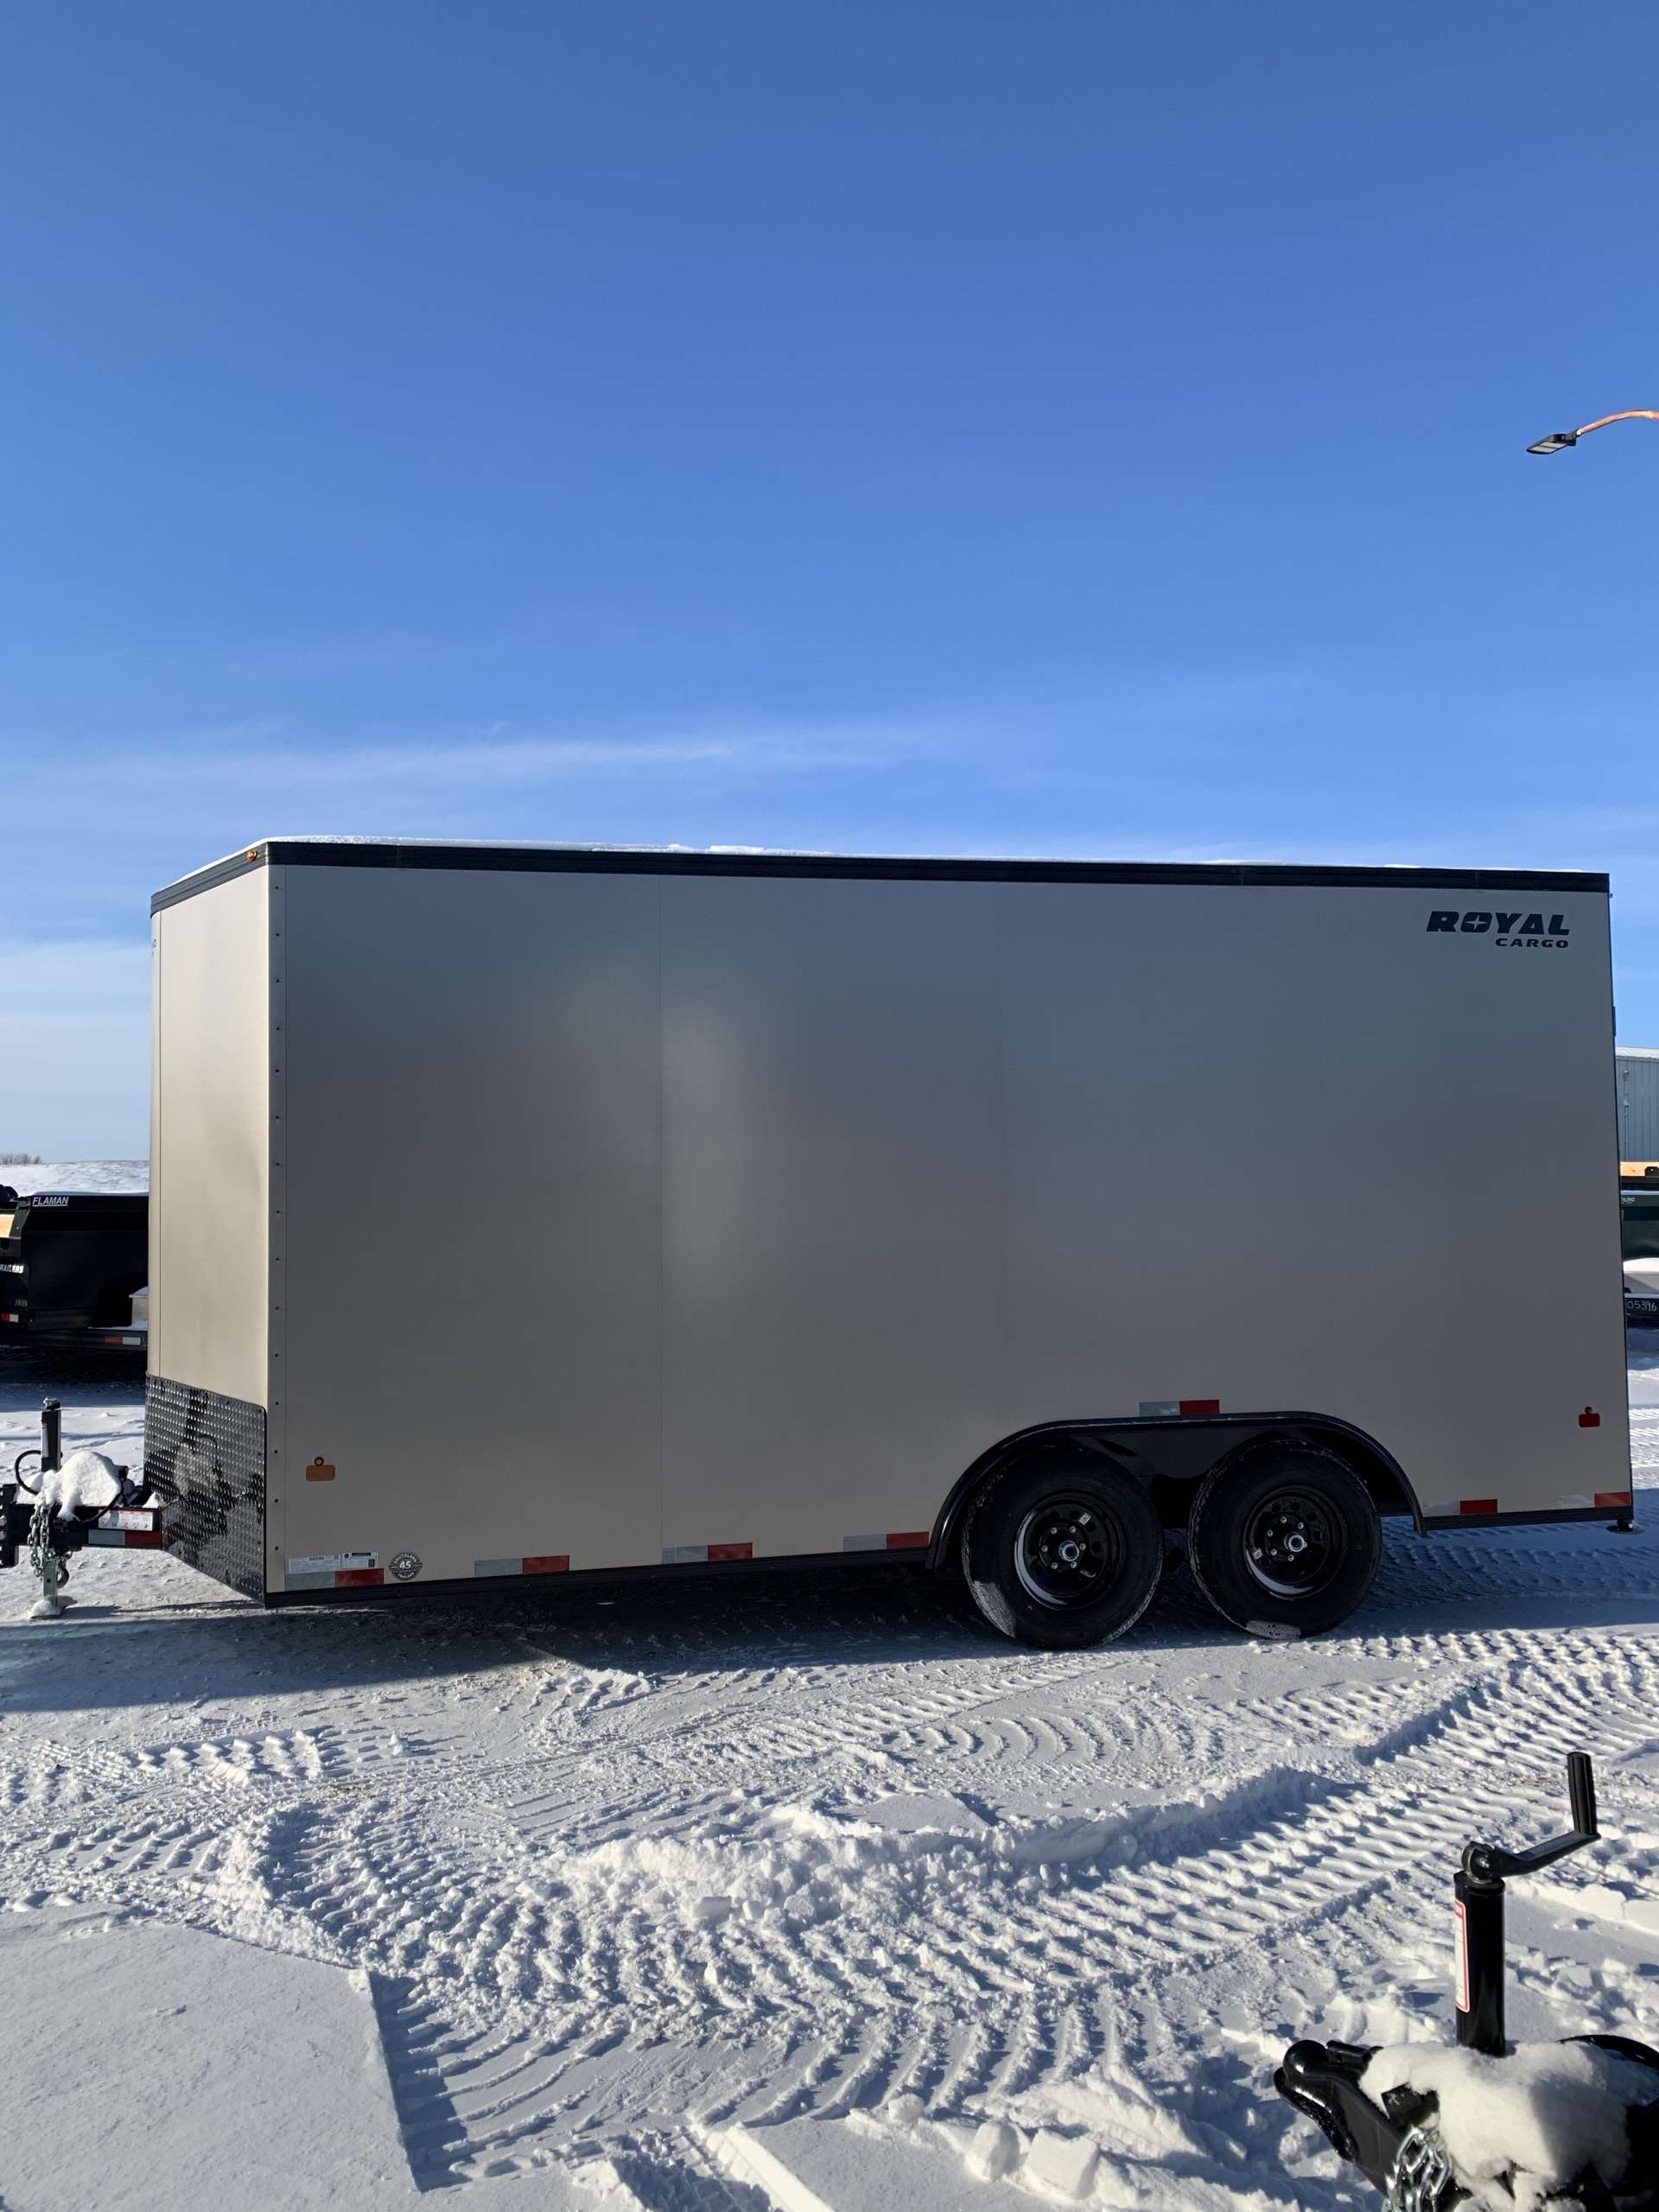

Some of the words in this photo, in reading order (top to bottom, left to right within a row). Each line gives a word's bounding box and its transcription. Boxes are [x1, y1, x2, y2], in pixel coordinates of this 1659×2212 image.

[1427, 911, 1570, 936] ROYAL
[1495, 938, 1569, 949] CARGO
[32, 1196, 69, 1205] FLAMAN
[399, 1560, 411, 1569] 45
